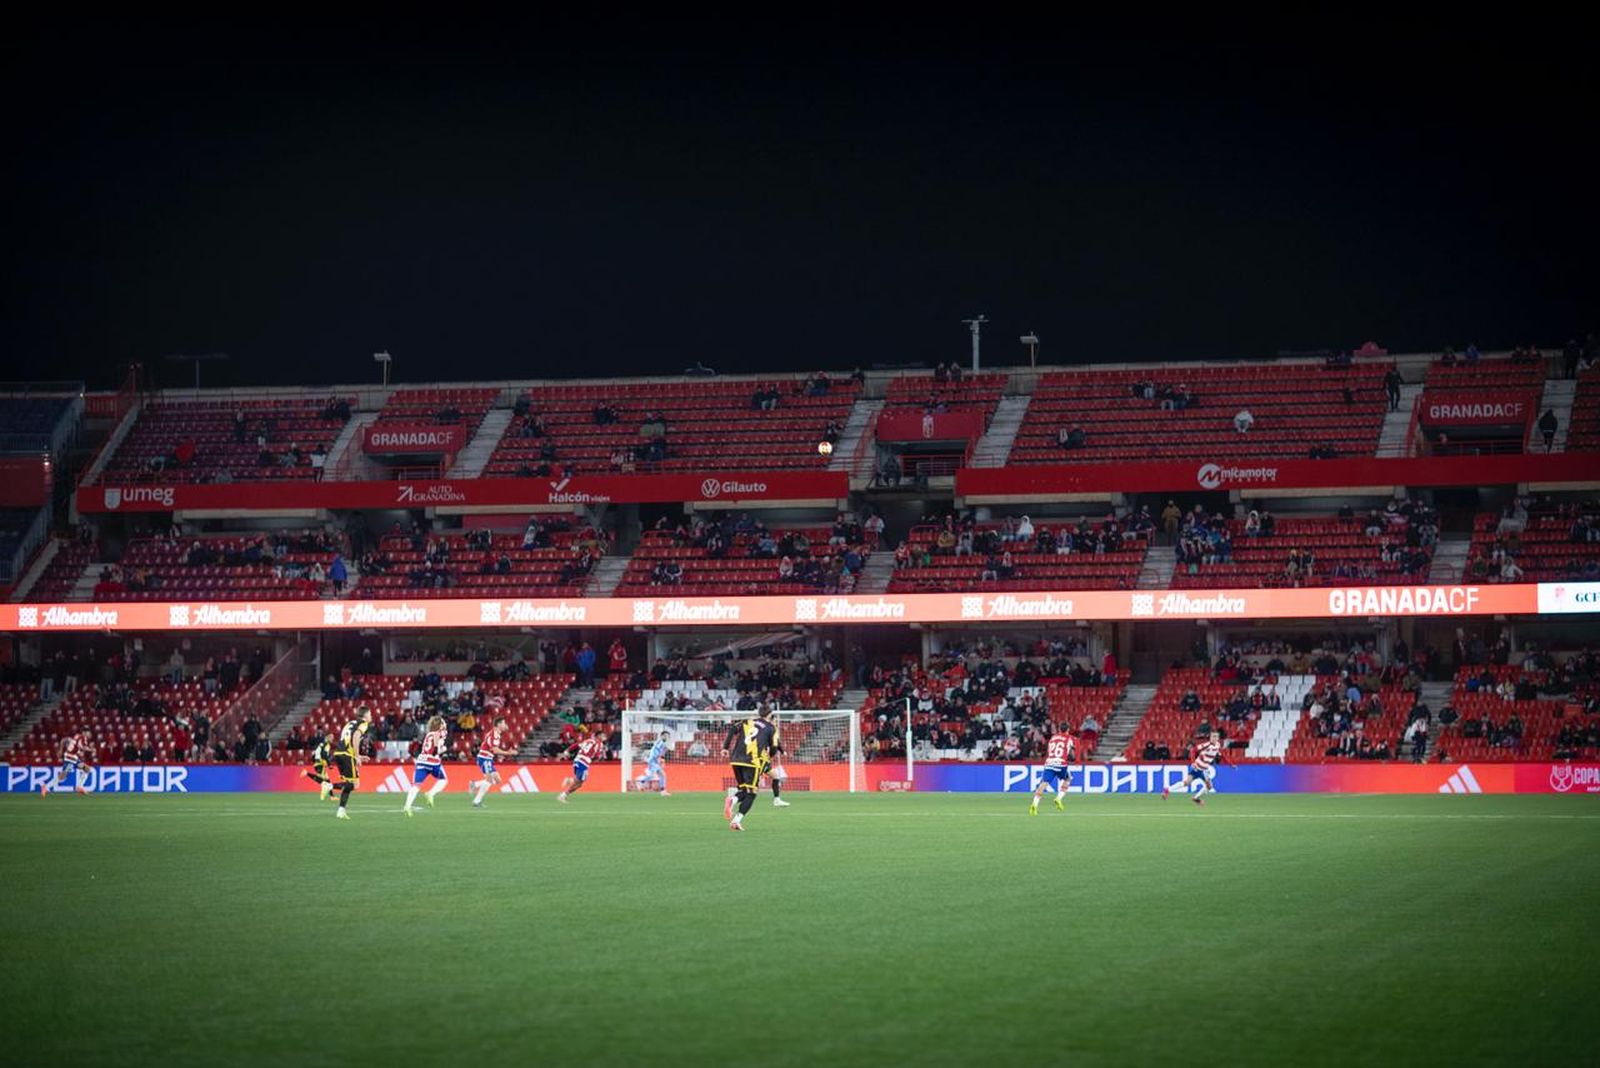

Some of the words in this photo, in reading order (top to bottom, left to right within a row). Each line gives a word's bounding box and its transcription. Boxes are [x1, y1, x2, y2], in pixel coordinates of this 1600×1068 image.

[123, 488, 175, 506] umeg
[413, 492, 465, 501] GRANADINA
[429, 485, 453, 493] AUTO
[549, 491, 590, 503] Halcón
[722, 481, 767, 493] Gilauto
[658, 600, 740, 620] Alhambra
[822, 599, 905, 619] Alhambra
[987, 596, 1073, 616] Alhambra
[1159, 593, 1245, 613] Alhambra
[1329, 588, 1479, 614] GRANADACF
[42, 606, 118, 626] Alhambra
[194, 605, 271, 625] Alhambra
[348, 604, 427, 624] Alhambra
[505, 602, 586, 622] Alhambra
[1048, 741, 1065, 757] 26
